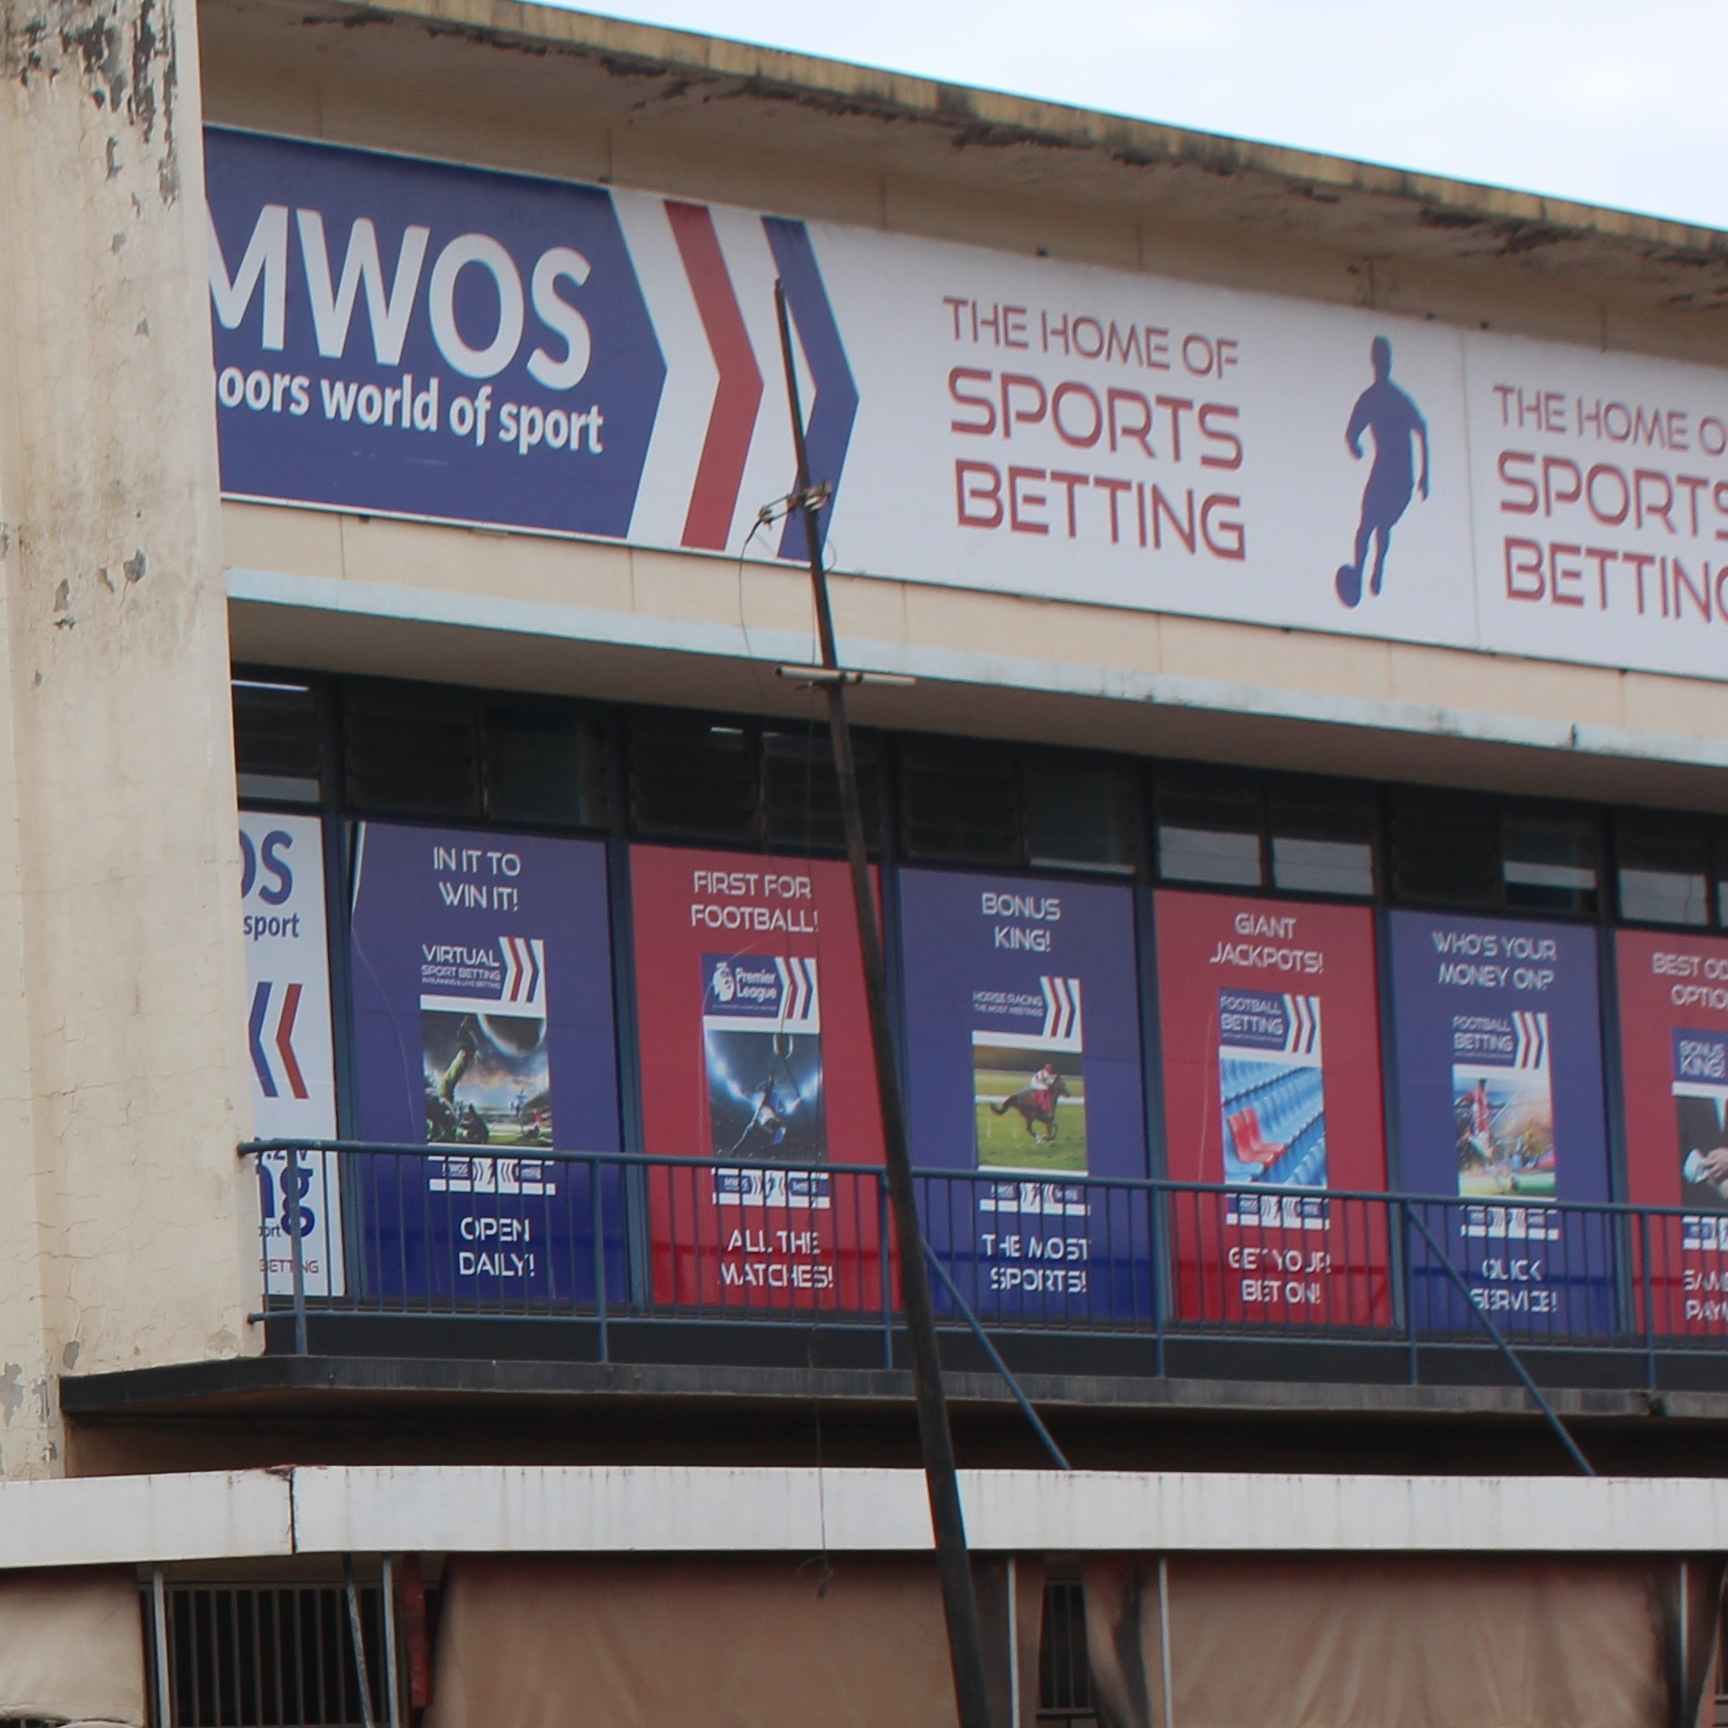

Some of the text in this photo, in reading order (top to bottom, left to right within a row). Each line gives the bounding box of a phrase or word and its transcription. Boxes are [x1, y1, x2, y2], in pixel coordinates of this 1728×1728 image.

[207, 204, 592, 391] MWOS
[944, 296, 1239, 379] THE HOME OF
[320, 376, 439, 432] world
[450, 386, 494, 446] of
[498, 403, 604, 455] sport
[948, 366, 1244, 471] SPORTS
[1493, 385, 1728, 456] THE HOME O
[955, 459, 1247, 562] BETTING
[433, 846, 522, 877] IN IT TO
[438, 881, 519, 912] WIN IT!
[693, 869, 813, 900] FIRST FOR
[691, 903, 820, 933] FOOTBALL!
[981, 891, 1062, 922] BONUS
[242, 912, 301, 941] sport
[1234, 911, 1296, 939] GIANT
[994, 926, 1052, 953] KING!
[1431, 930, 1557, 961] WHO'S YOUR
[421, 943, 500, 968] VIRTUAL
[1209, 940, 1325, 974] JACKPOTS!
[1652, 951, 1702, 977] BEST
[420, 964, 502, 981] SPORT BETTING
[735, 967, 777, 984] Premier
[1438, 962, 1555, 991] MONEY ON?
[736, 984, 778, 1003] League
[1221, 995, 1282, 1015] FOOTBALL
[1671, 983, 1728, 1010] OPTIO
[1221, 1013, 1284, 1035] BETTING
[1454, 1032, 1514, 1052] BETTING
[460, 1216, 530, 1242] OPEN
[728, 1229, 822, 1255] ALL THE
[981, 1233, 1021, 1258] THE
[459, 1251, 535, 1277] DAILY!
[720, 1262, 834, 1289] MATCHES!
[990, 1267, 1087, 1293] SPORTS!
